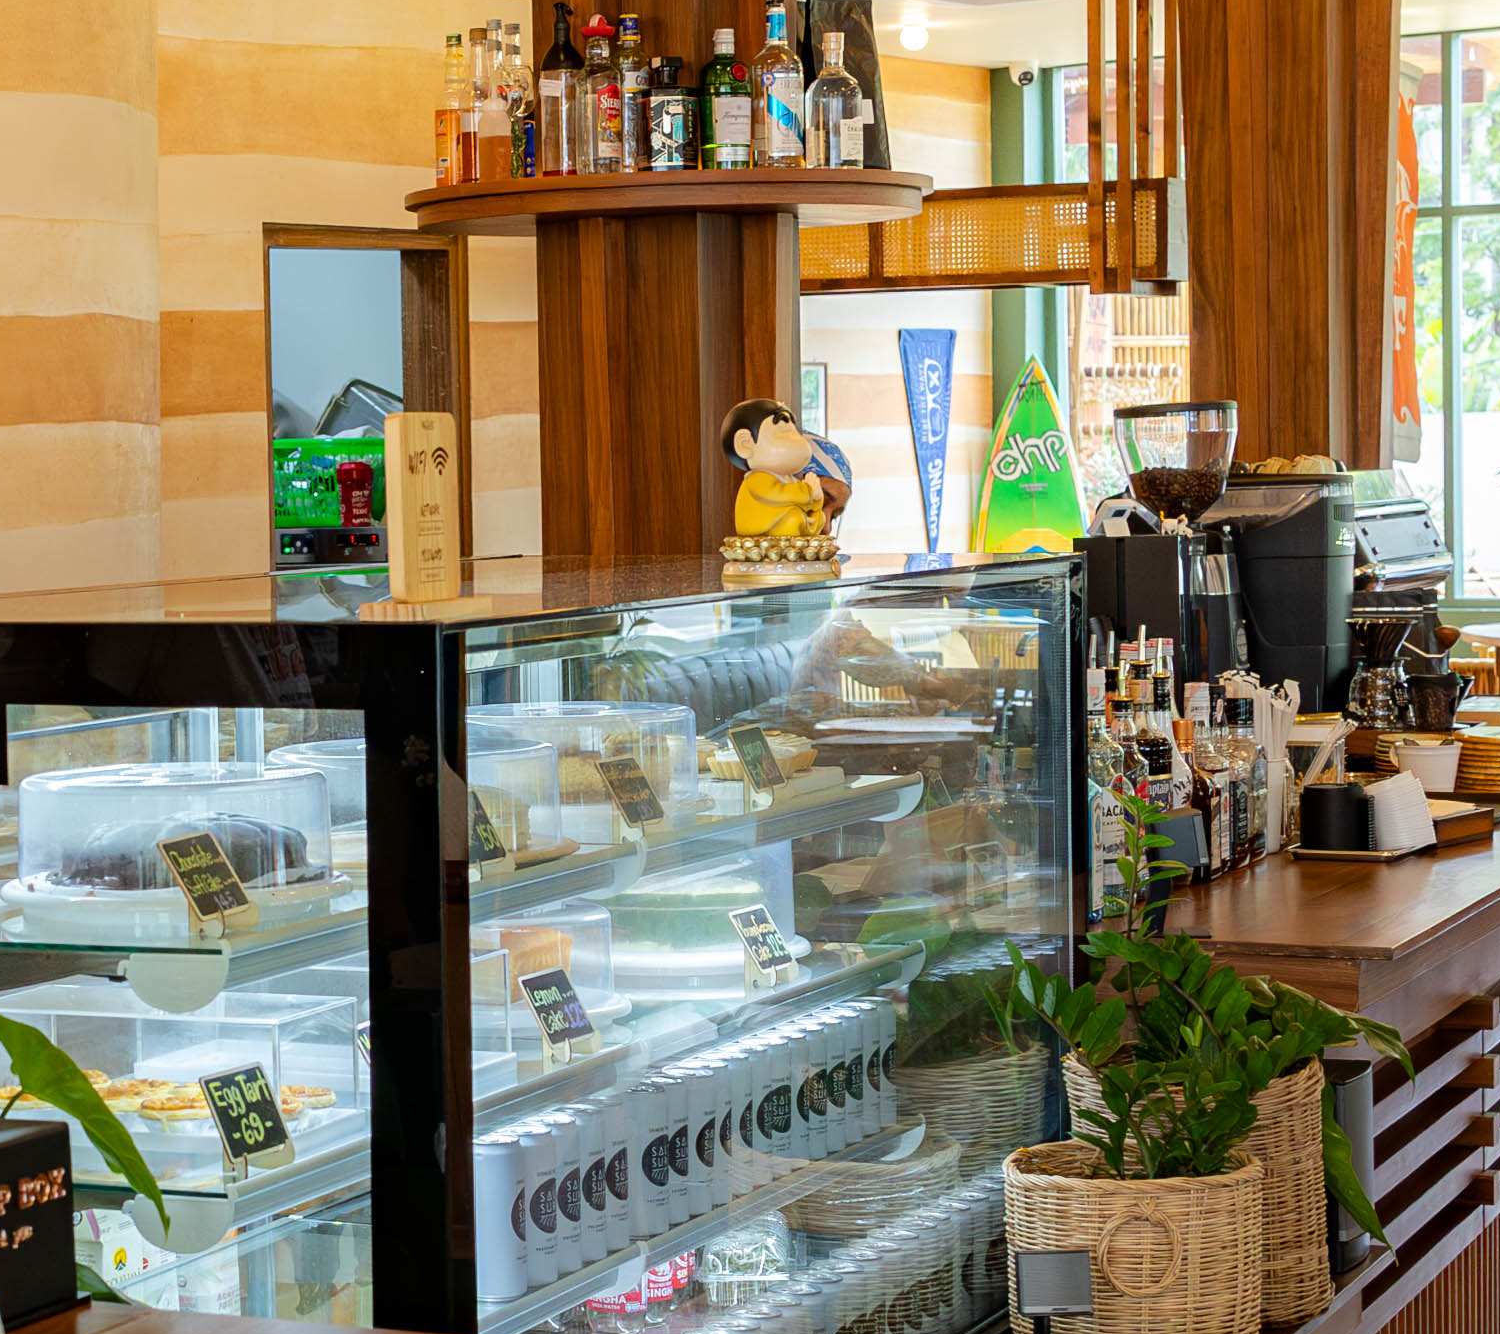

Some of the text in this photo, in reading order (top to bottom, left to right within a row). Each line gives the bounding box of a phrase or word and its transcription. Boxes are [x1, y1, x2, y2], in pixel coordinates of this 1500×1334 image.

[927, 457, 943, 539] SURFING
[526, 985, 562, 1008] Lemon
[540, 1009, 569, 1035] Cake
[207, 1068, 272, 1117] Egg Tart
[17, 1166, 66, 1210] BOX
